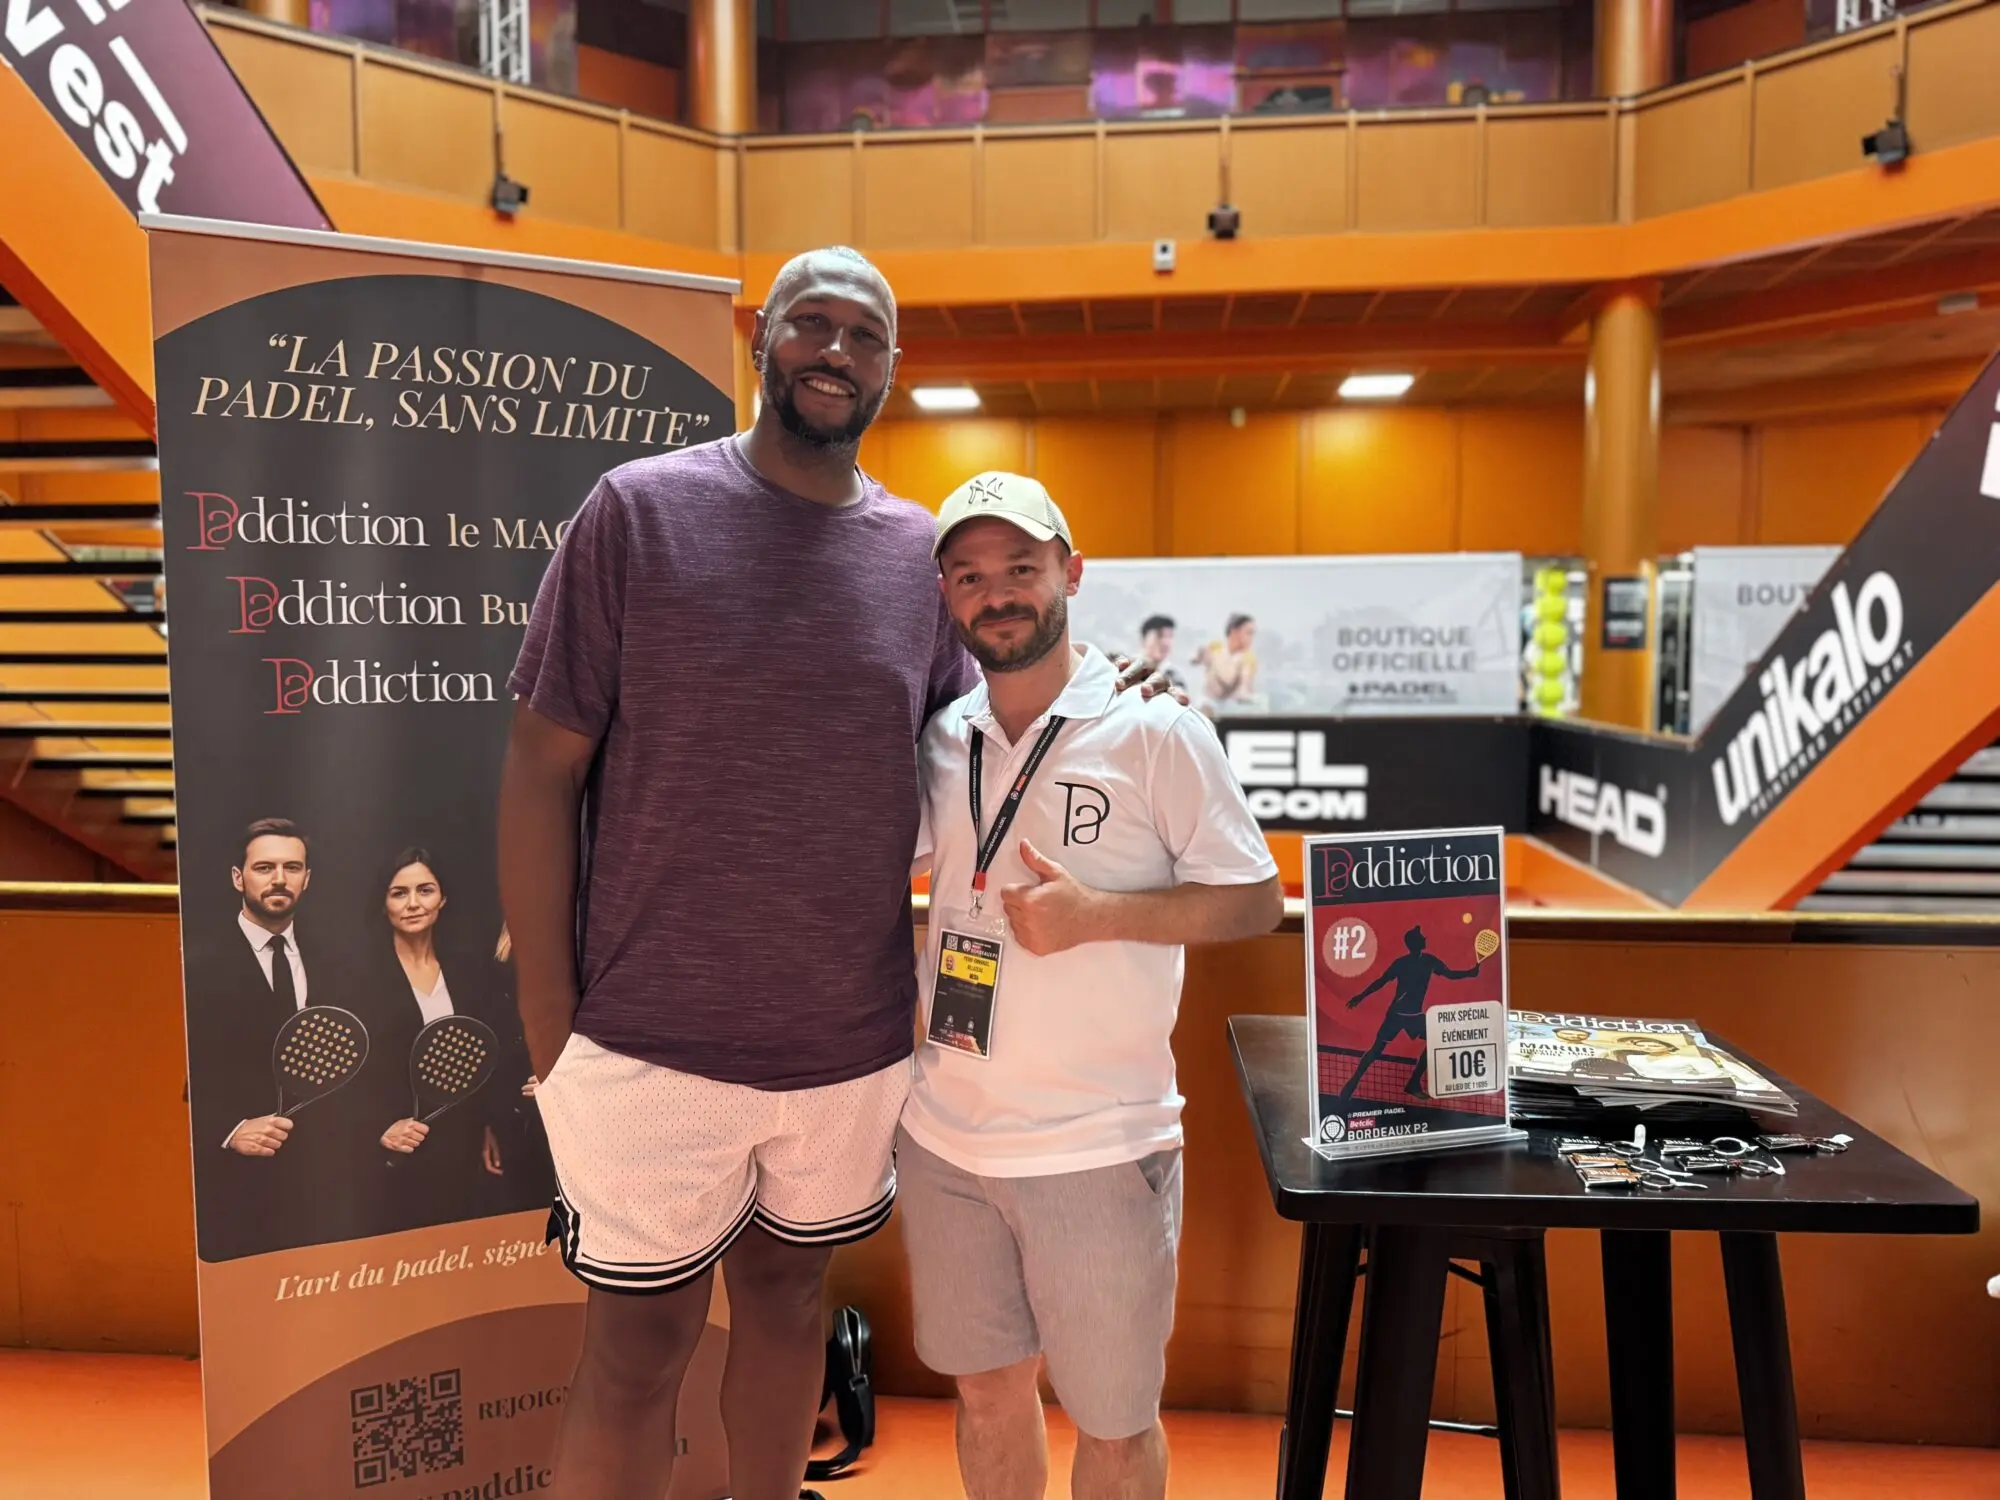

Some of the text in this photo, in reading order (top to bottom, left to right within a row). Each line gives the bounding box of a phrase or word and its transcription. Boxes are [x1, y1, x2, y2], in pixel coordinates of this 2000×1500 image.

[269, 333, 652, 400] “LA PASSION DU
[192, 377, 710, 447] PADEL, SANS LIMITE”
[184, 492, 430, 550] Paddiction
[447, 513, 480, 548] le
[226, 577, 467, 633] Paddiction
[1337, 626, 1472, 648] BOUTIQUE
[1332, 651, 1476, 672] OFFICIELLE
[261, 658, 498, 714] Paddiction
[1711, 570, 1903, 825] unikalo
[1540, 764, 1666, 858] HEAD
[1314, 844, 1497, 898] Paddiction
[1333, 925, 1366, 960] #2
[1437, 1008, 1490, 1023] PRIX SPÉCIAL
[1441, 1027, 1488, 1042] ÉVÉNEMENT
[1449, 1049, 1486, 1079] 10€
[1349, 1118, 1376, 1129] Betclic
[1352, 1107, 1406, 1118] PREMIER PADEL
[1347, 1122, 1429, 1140] BORDEAUX P2
[349, 1263, 384, 1289] du
